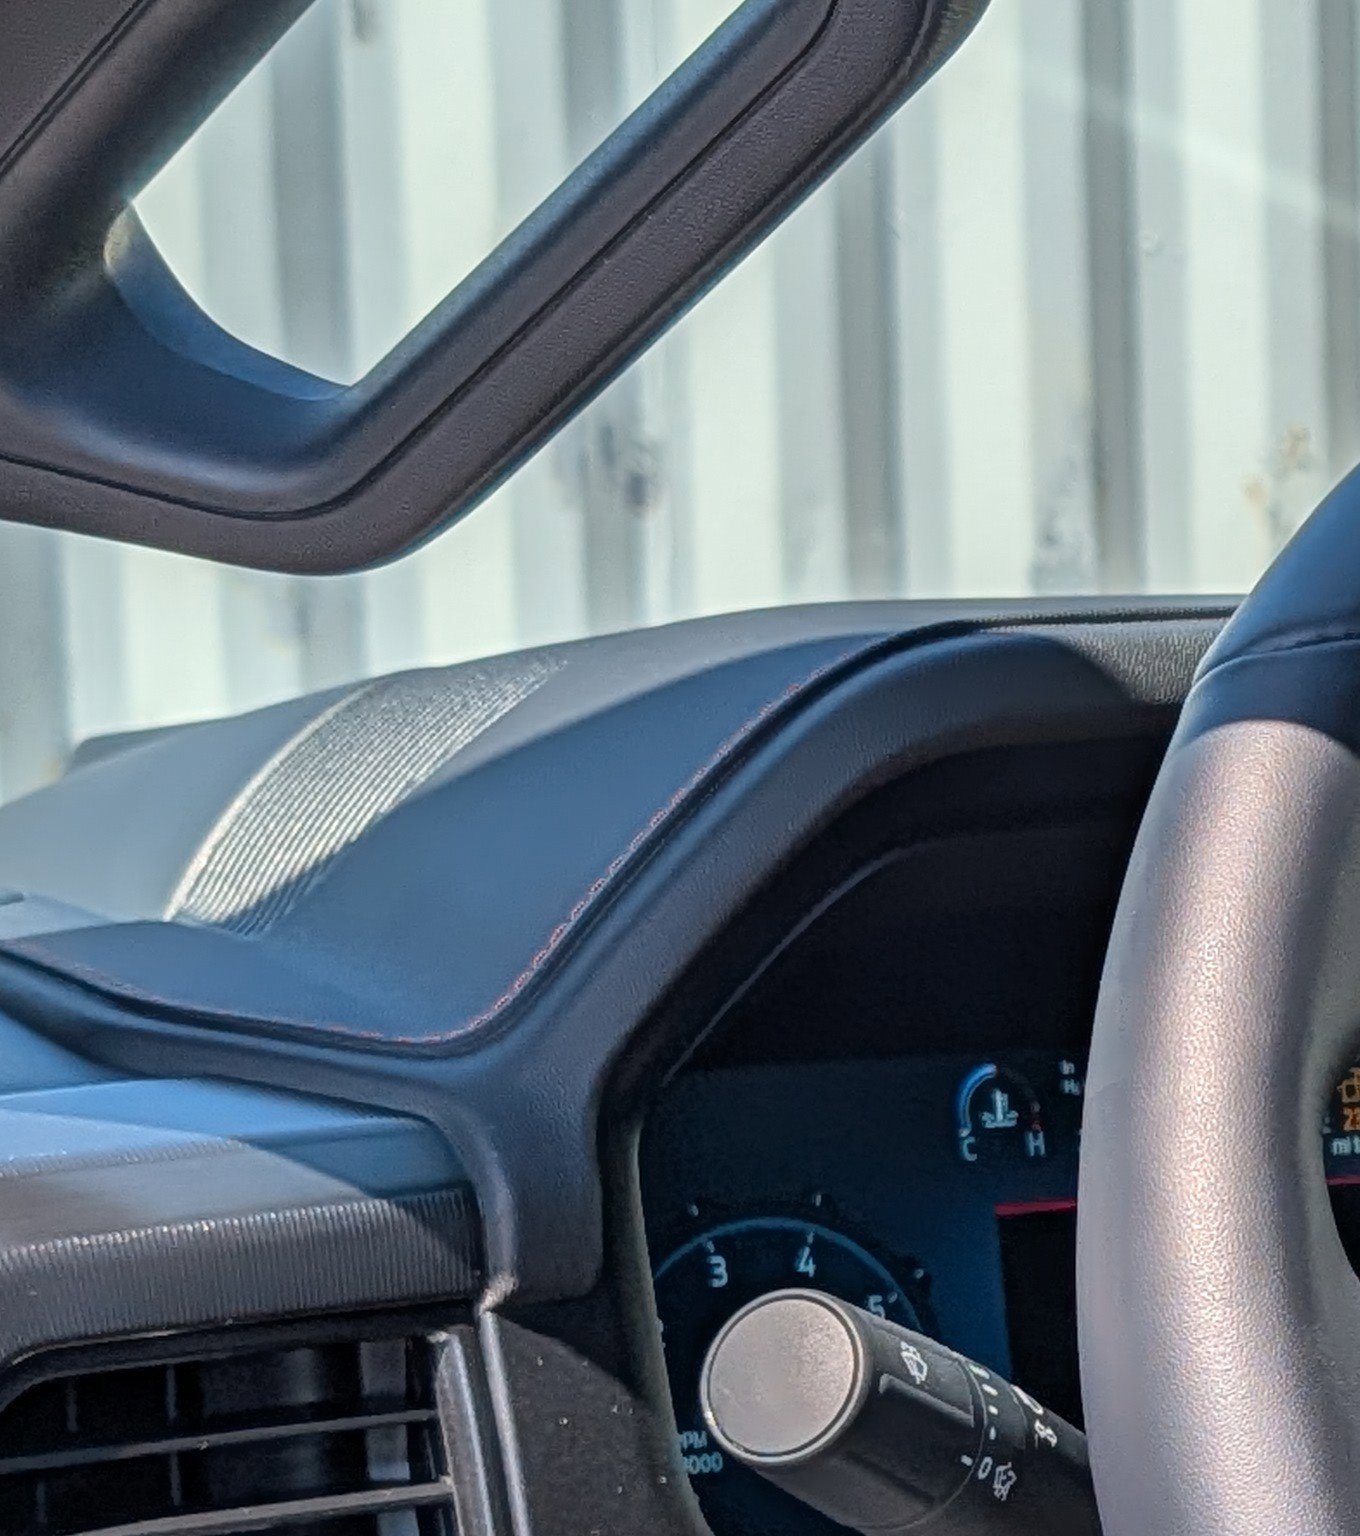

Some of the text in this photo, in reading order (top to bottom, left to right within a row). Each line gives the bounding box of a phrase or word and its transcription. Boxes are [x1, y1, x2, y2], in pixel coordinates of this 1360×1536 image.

[960, 1135, 978, 1162] C
[1025, 1130, 1046, 1158] H
[706, 1254, 728, 1288] 3
[795, 1246, 816, 1278] 4
[680, 1430, 707, 1449] PM
